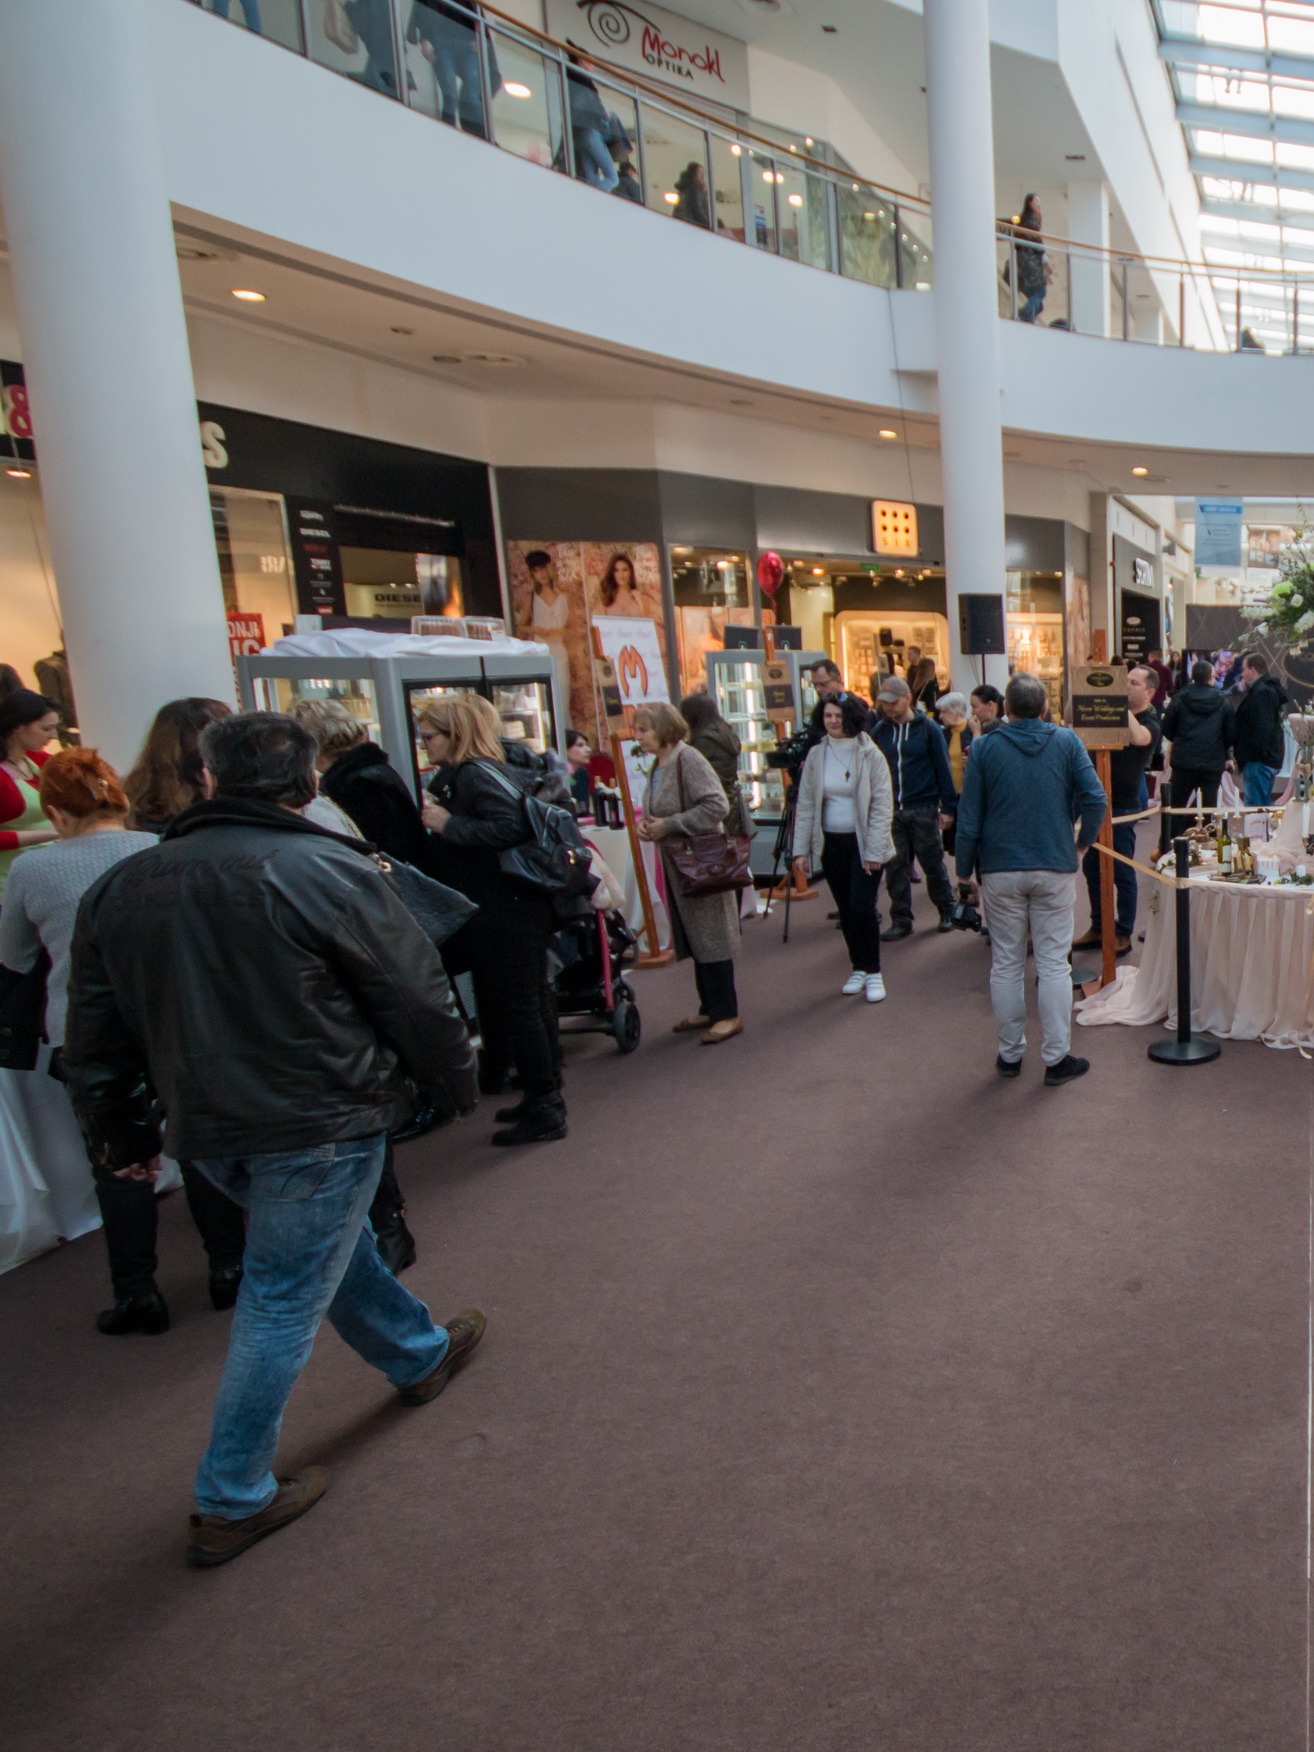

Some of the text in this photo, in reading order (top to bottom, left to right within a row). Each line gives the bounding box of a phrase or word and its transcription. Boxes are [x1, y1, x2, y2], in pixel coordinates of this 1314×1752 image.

[641, 25, 726, 83] Monokl
[646, 53, 694, 80] OPTIKA
[882, 536, 911, 548] SIX
